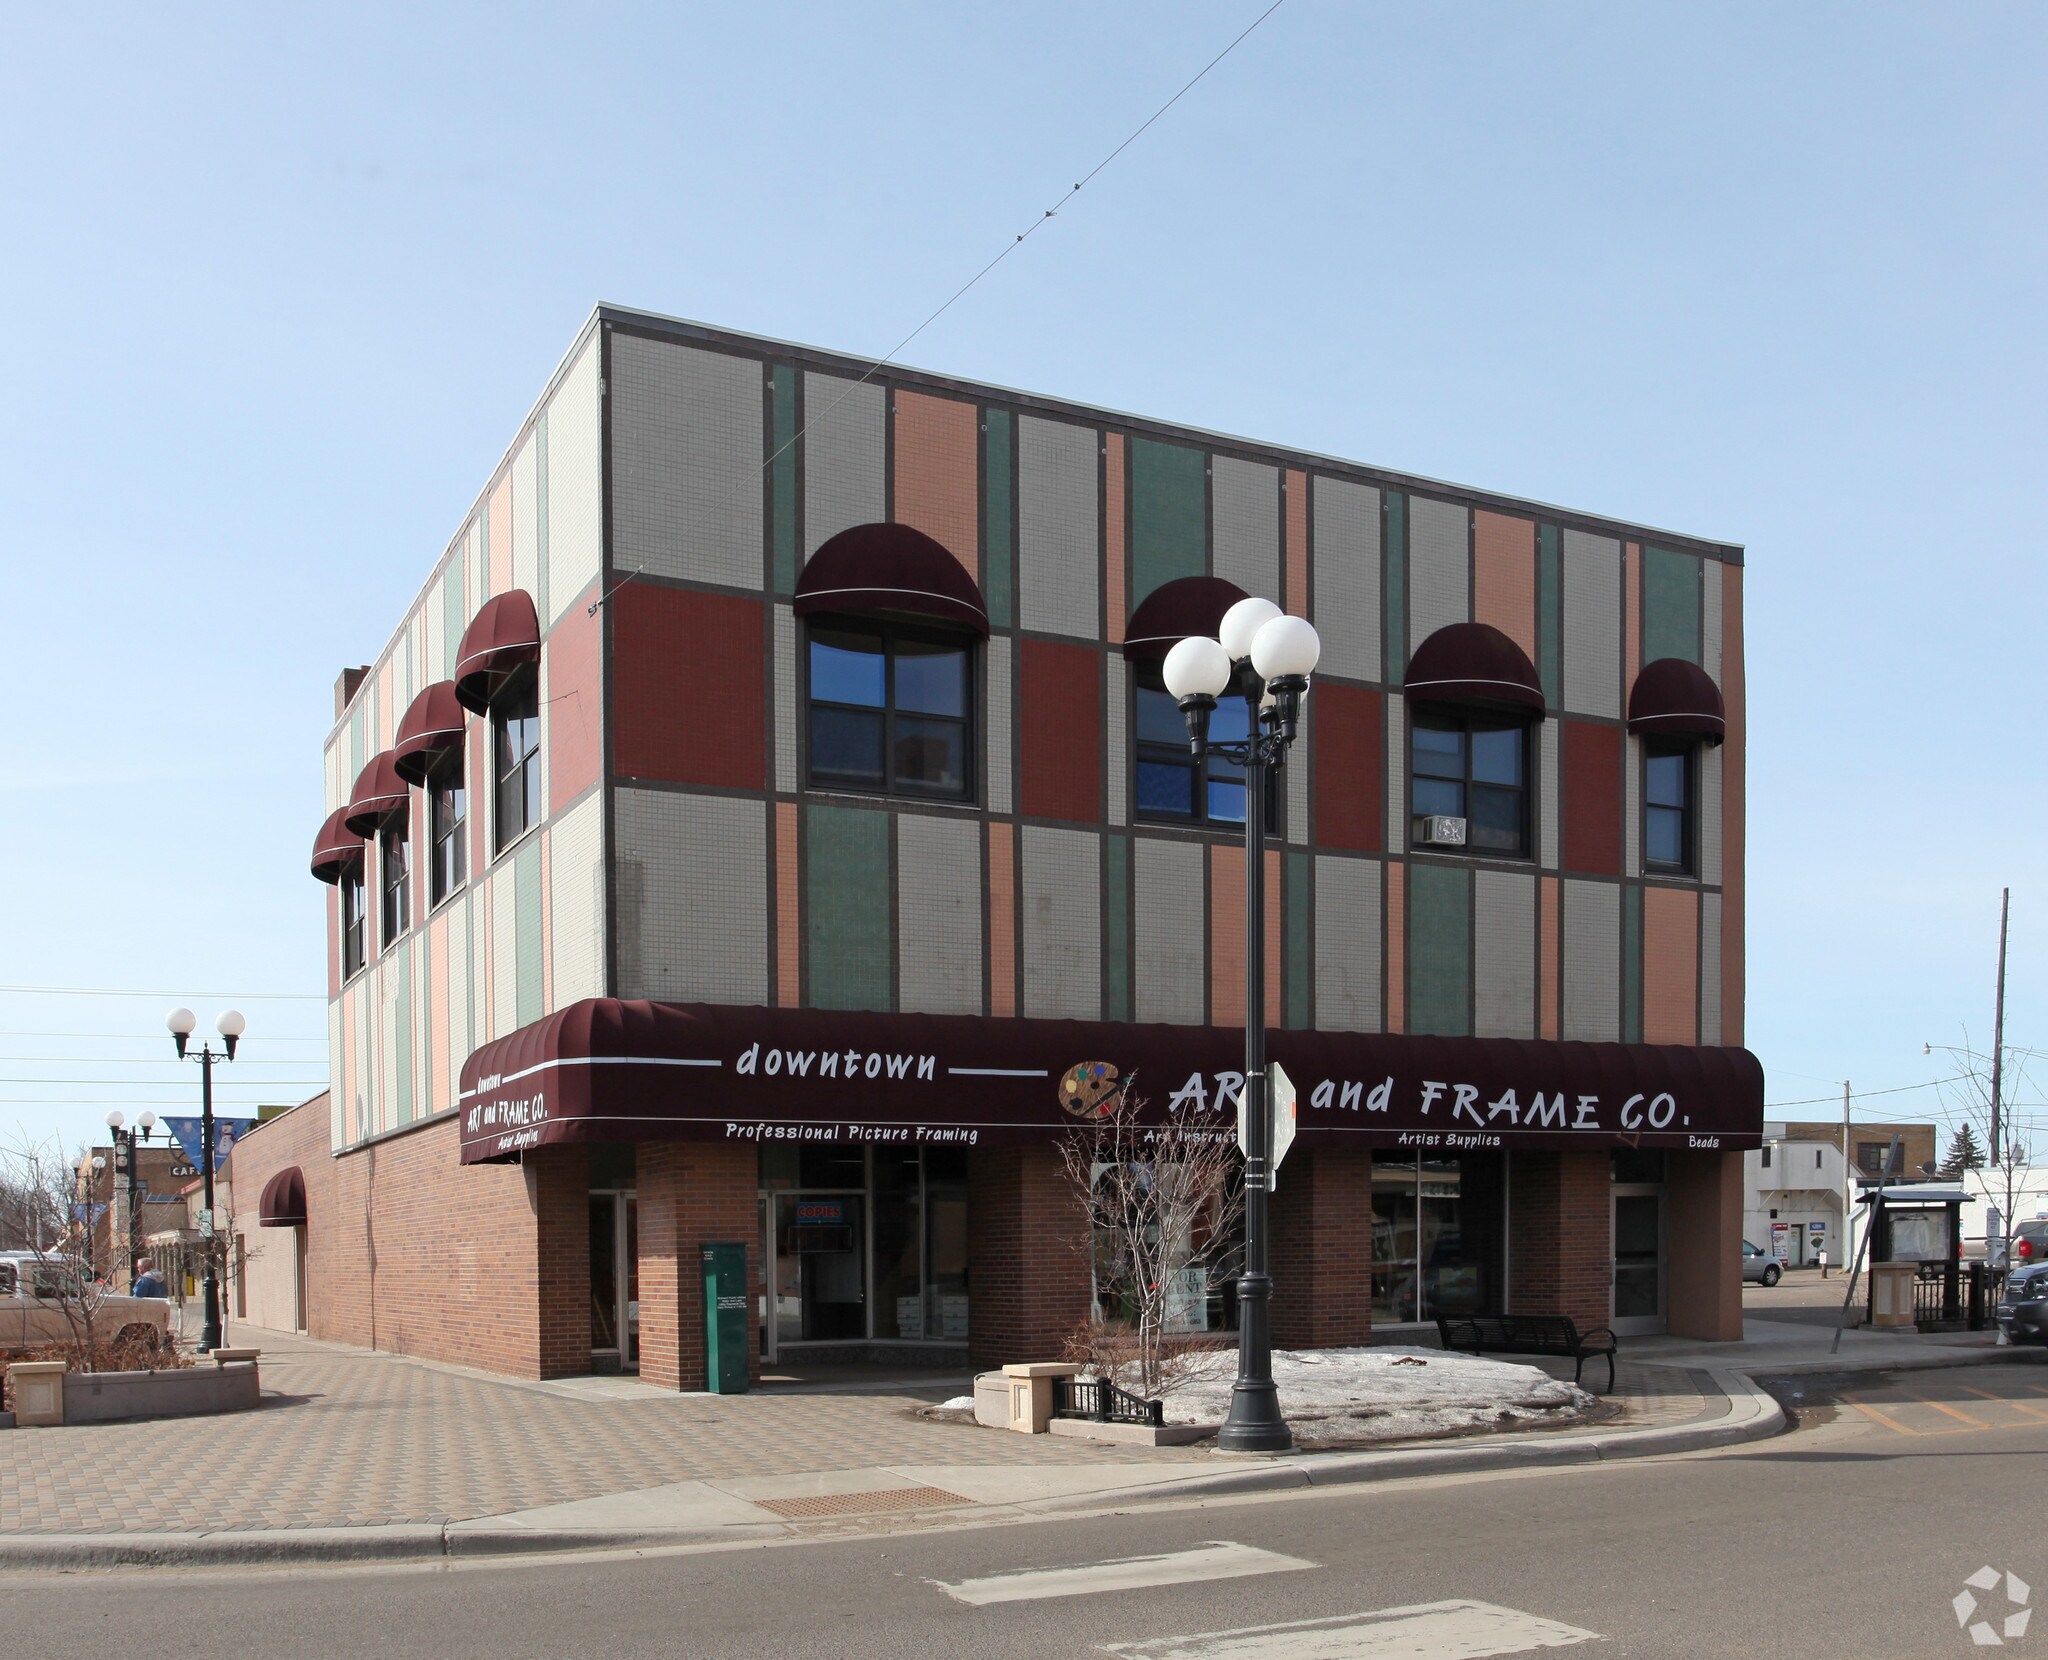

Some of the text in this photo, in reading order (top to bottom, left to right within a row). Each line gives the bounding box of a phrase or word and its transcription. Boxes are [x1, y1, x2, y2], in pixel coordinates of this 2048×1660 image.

[736, 1042, 936, 1081] downtown
[1168, 1071, 1690, 1129] AR and FRAME CO.
[467, 1092, 548, 1133] ART and FRAME CO.
[726, 1123, 979, 1145] Professional Picture Framing
[1398, 1133, 1501, 1149] Artist Supplies
[1688, 1135, 1720, 1148] Beads
[172, 1167, 201, 1176] CAF
[798, 1206, 841, 1218] COPIES
